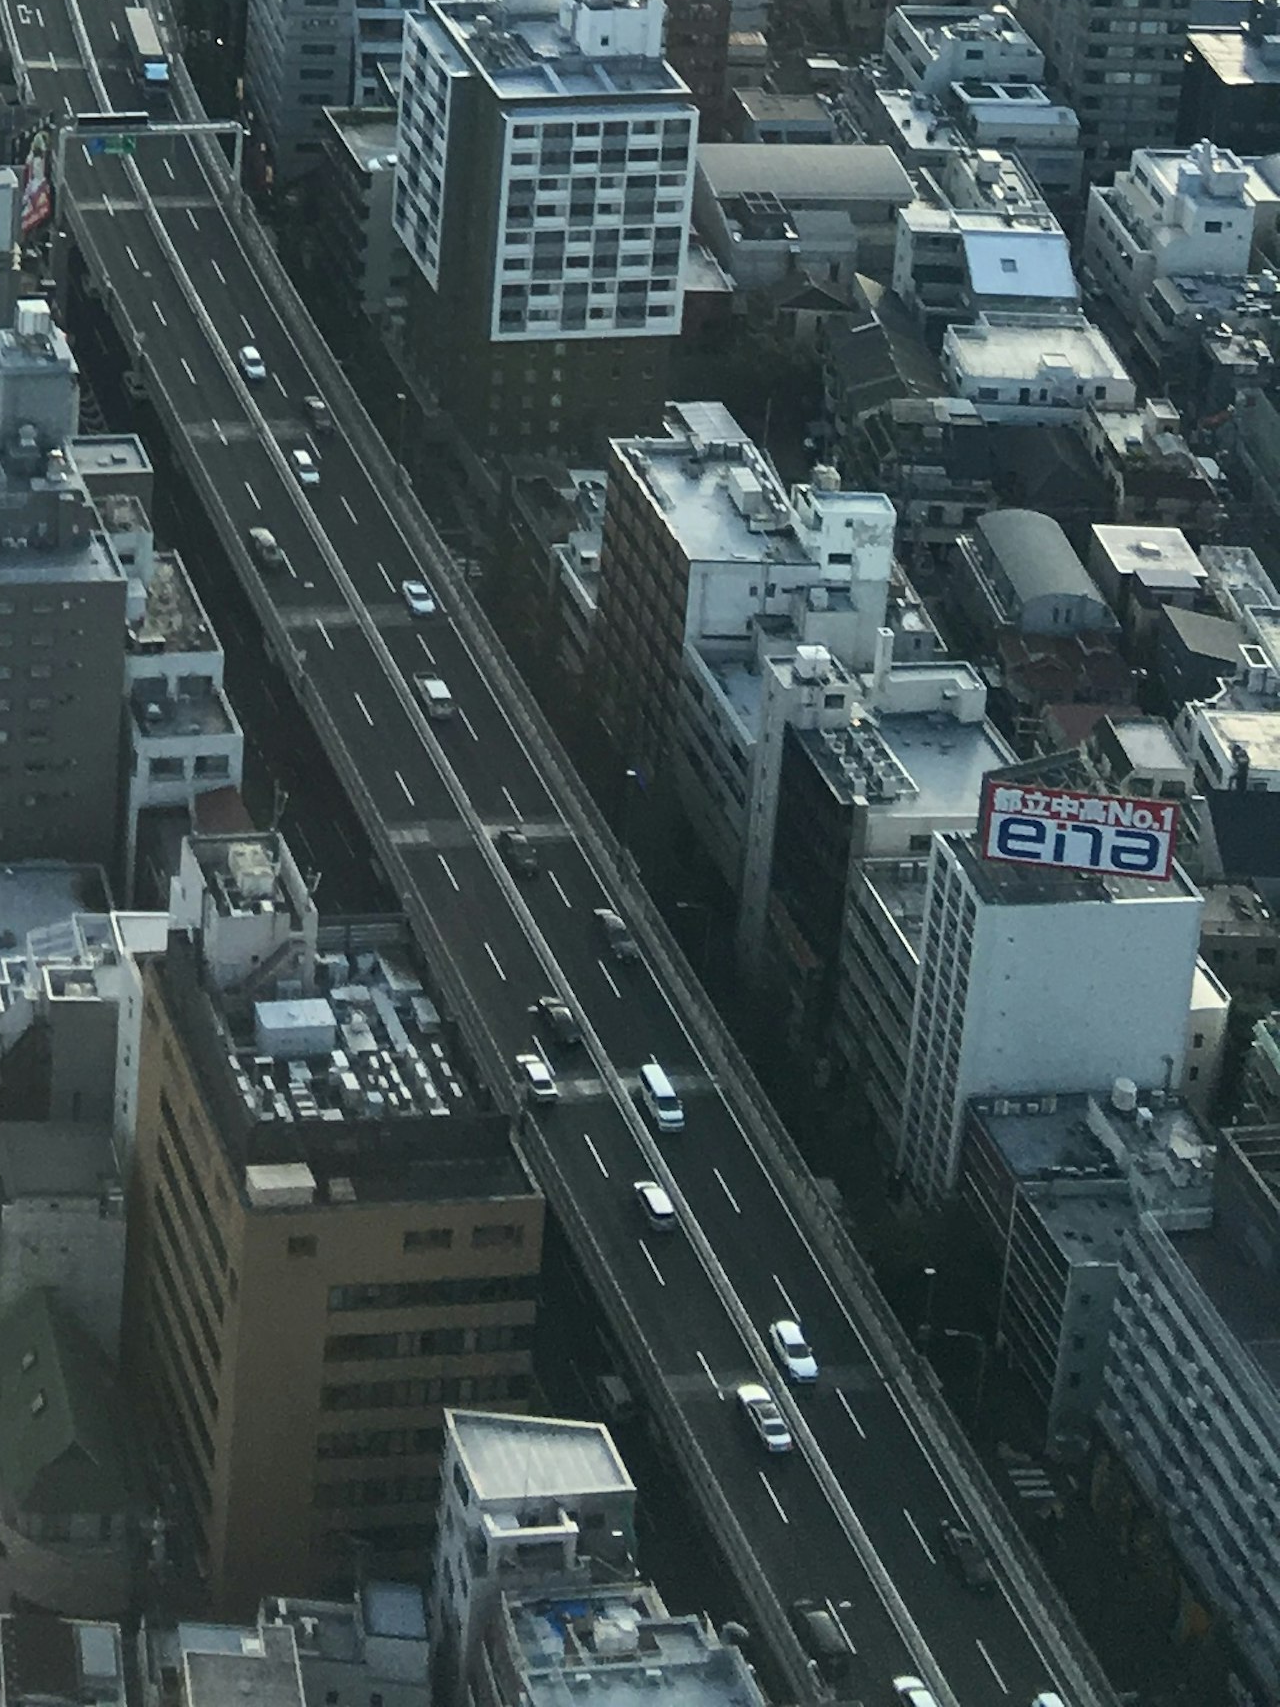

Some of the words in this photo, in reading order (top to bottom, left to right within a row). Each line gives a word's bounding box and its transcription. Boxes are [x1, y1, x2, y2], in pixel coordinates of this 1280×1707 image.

[993, 787, 1174, 832] 都立中高No.1
[997, 816, 1160, 872] ena
